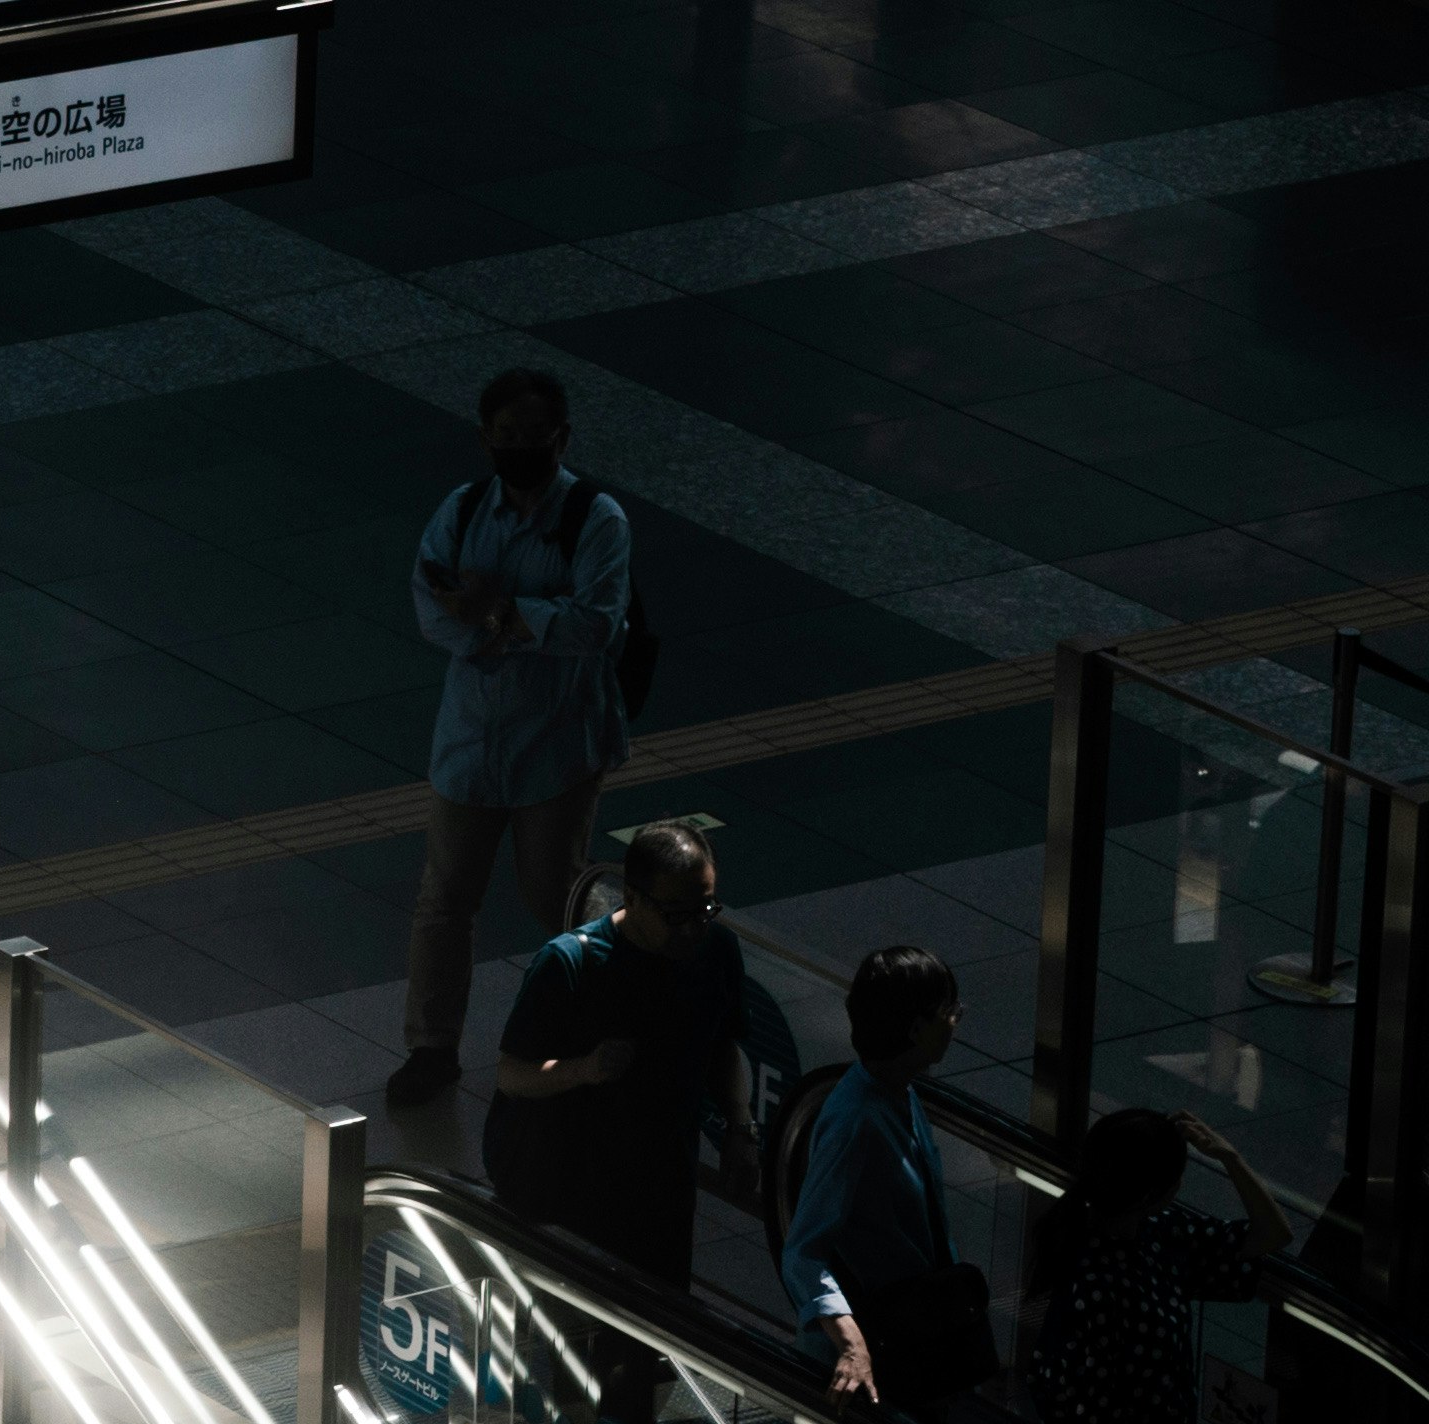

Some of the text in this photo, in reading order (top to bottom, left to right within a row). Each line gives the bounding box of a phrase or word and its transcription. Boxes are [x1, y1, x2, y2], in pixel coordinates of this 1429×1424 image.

[102, 136, 145, 156] Plaza
[380, 1250, 450, 1376] 5F
[379, 1360, 440, 1401] ノースゲートビル
